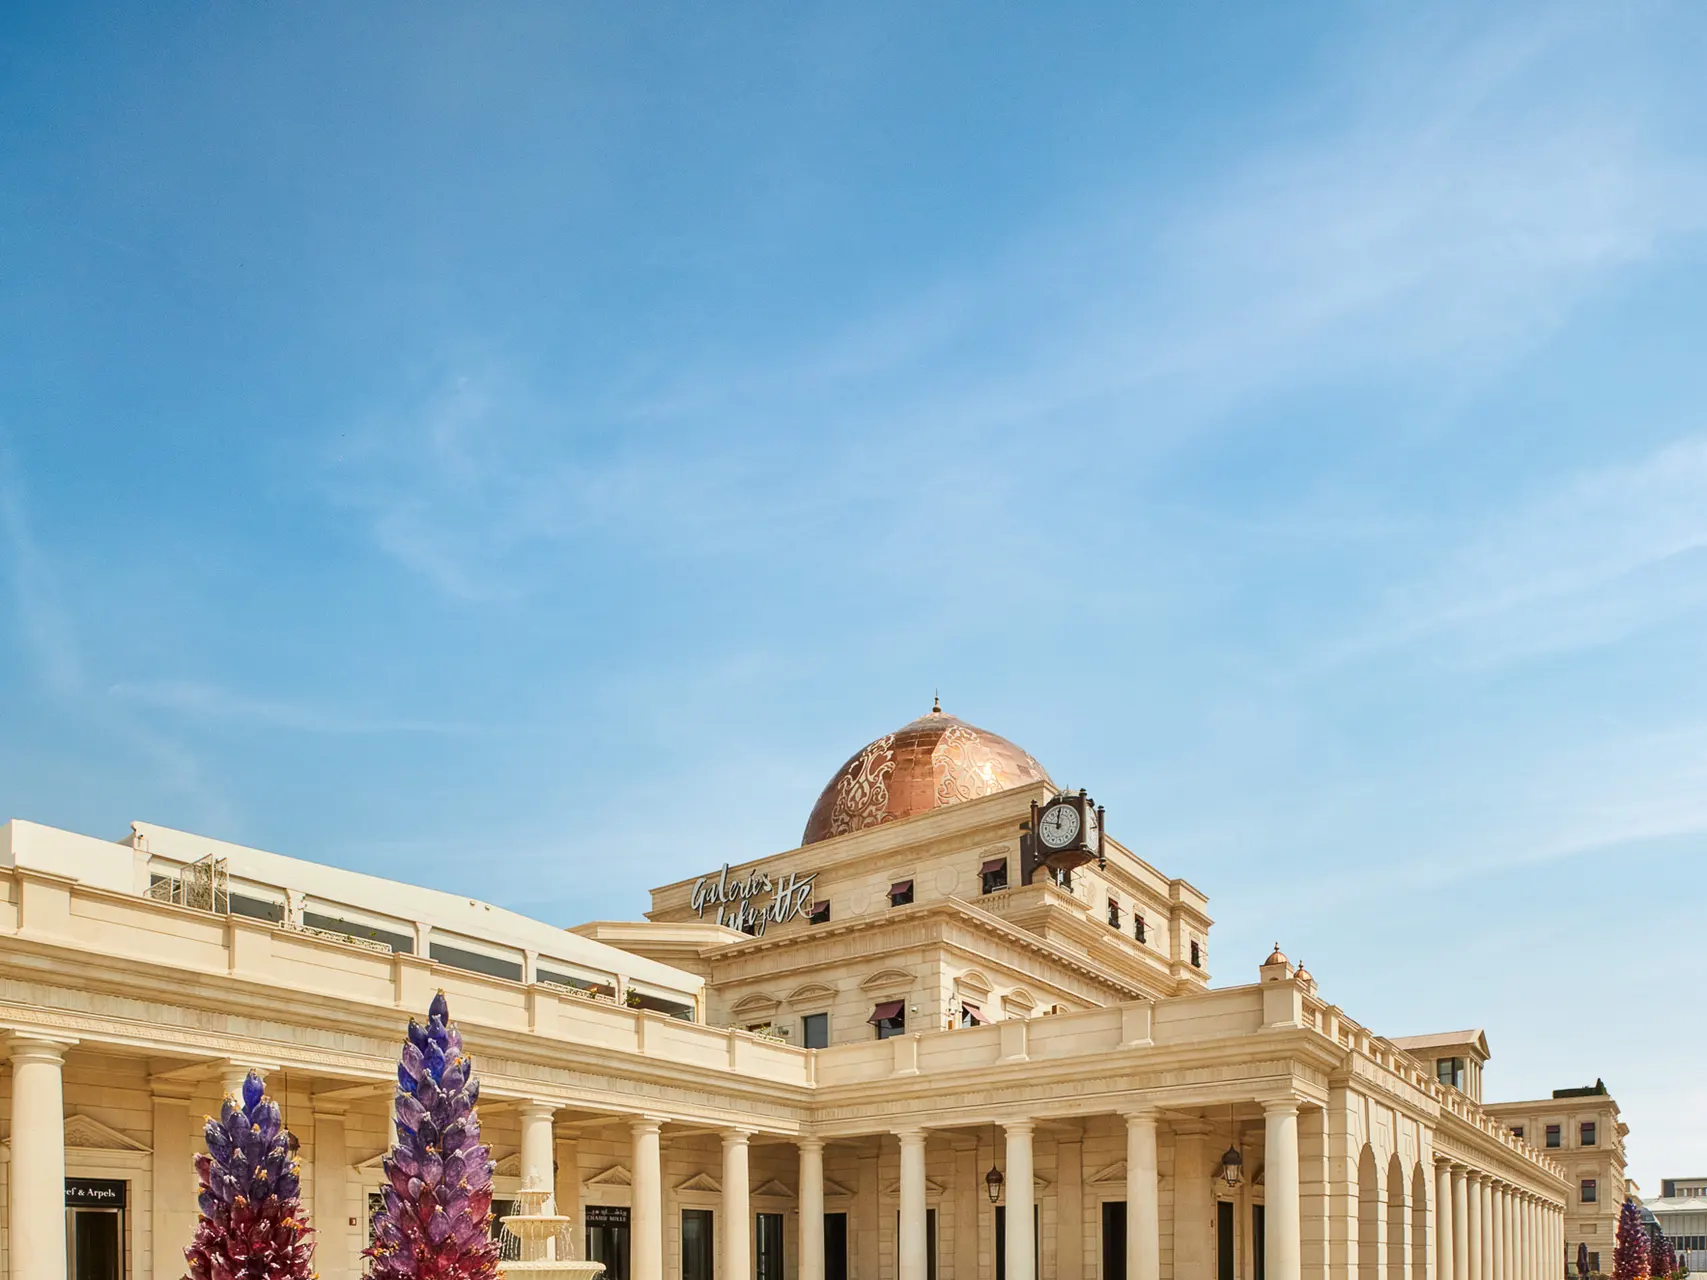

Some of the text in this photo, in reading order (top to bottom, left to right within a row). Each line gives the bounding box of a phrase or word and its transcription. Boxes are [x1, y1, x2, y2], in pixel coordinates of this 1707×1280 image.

[691, 863, 773, 919] Galeries
[77, 1188, 86, 1197] &
[86, 1187, 116, 1200] Arpels
